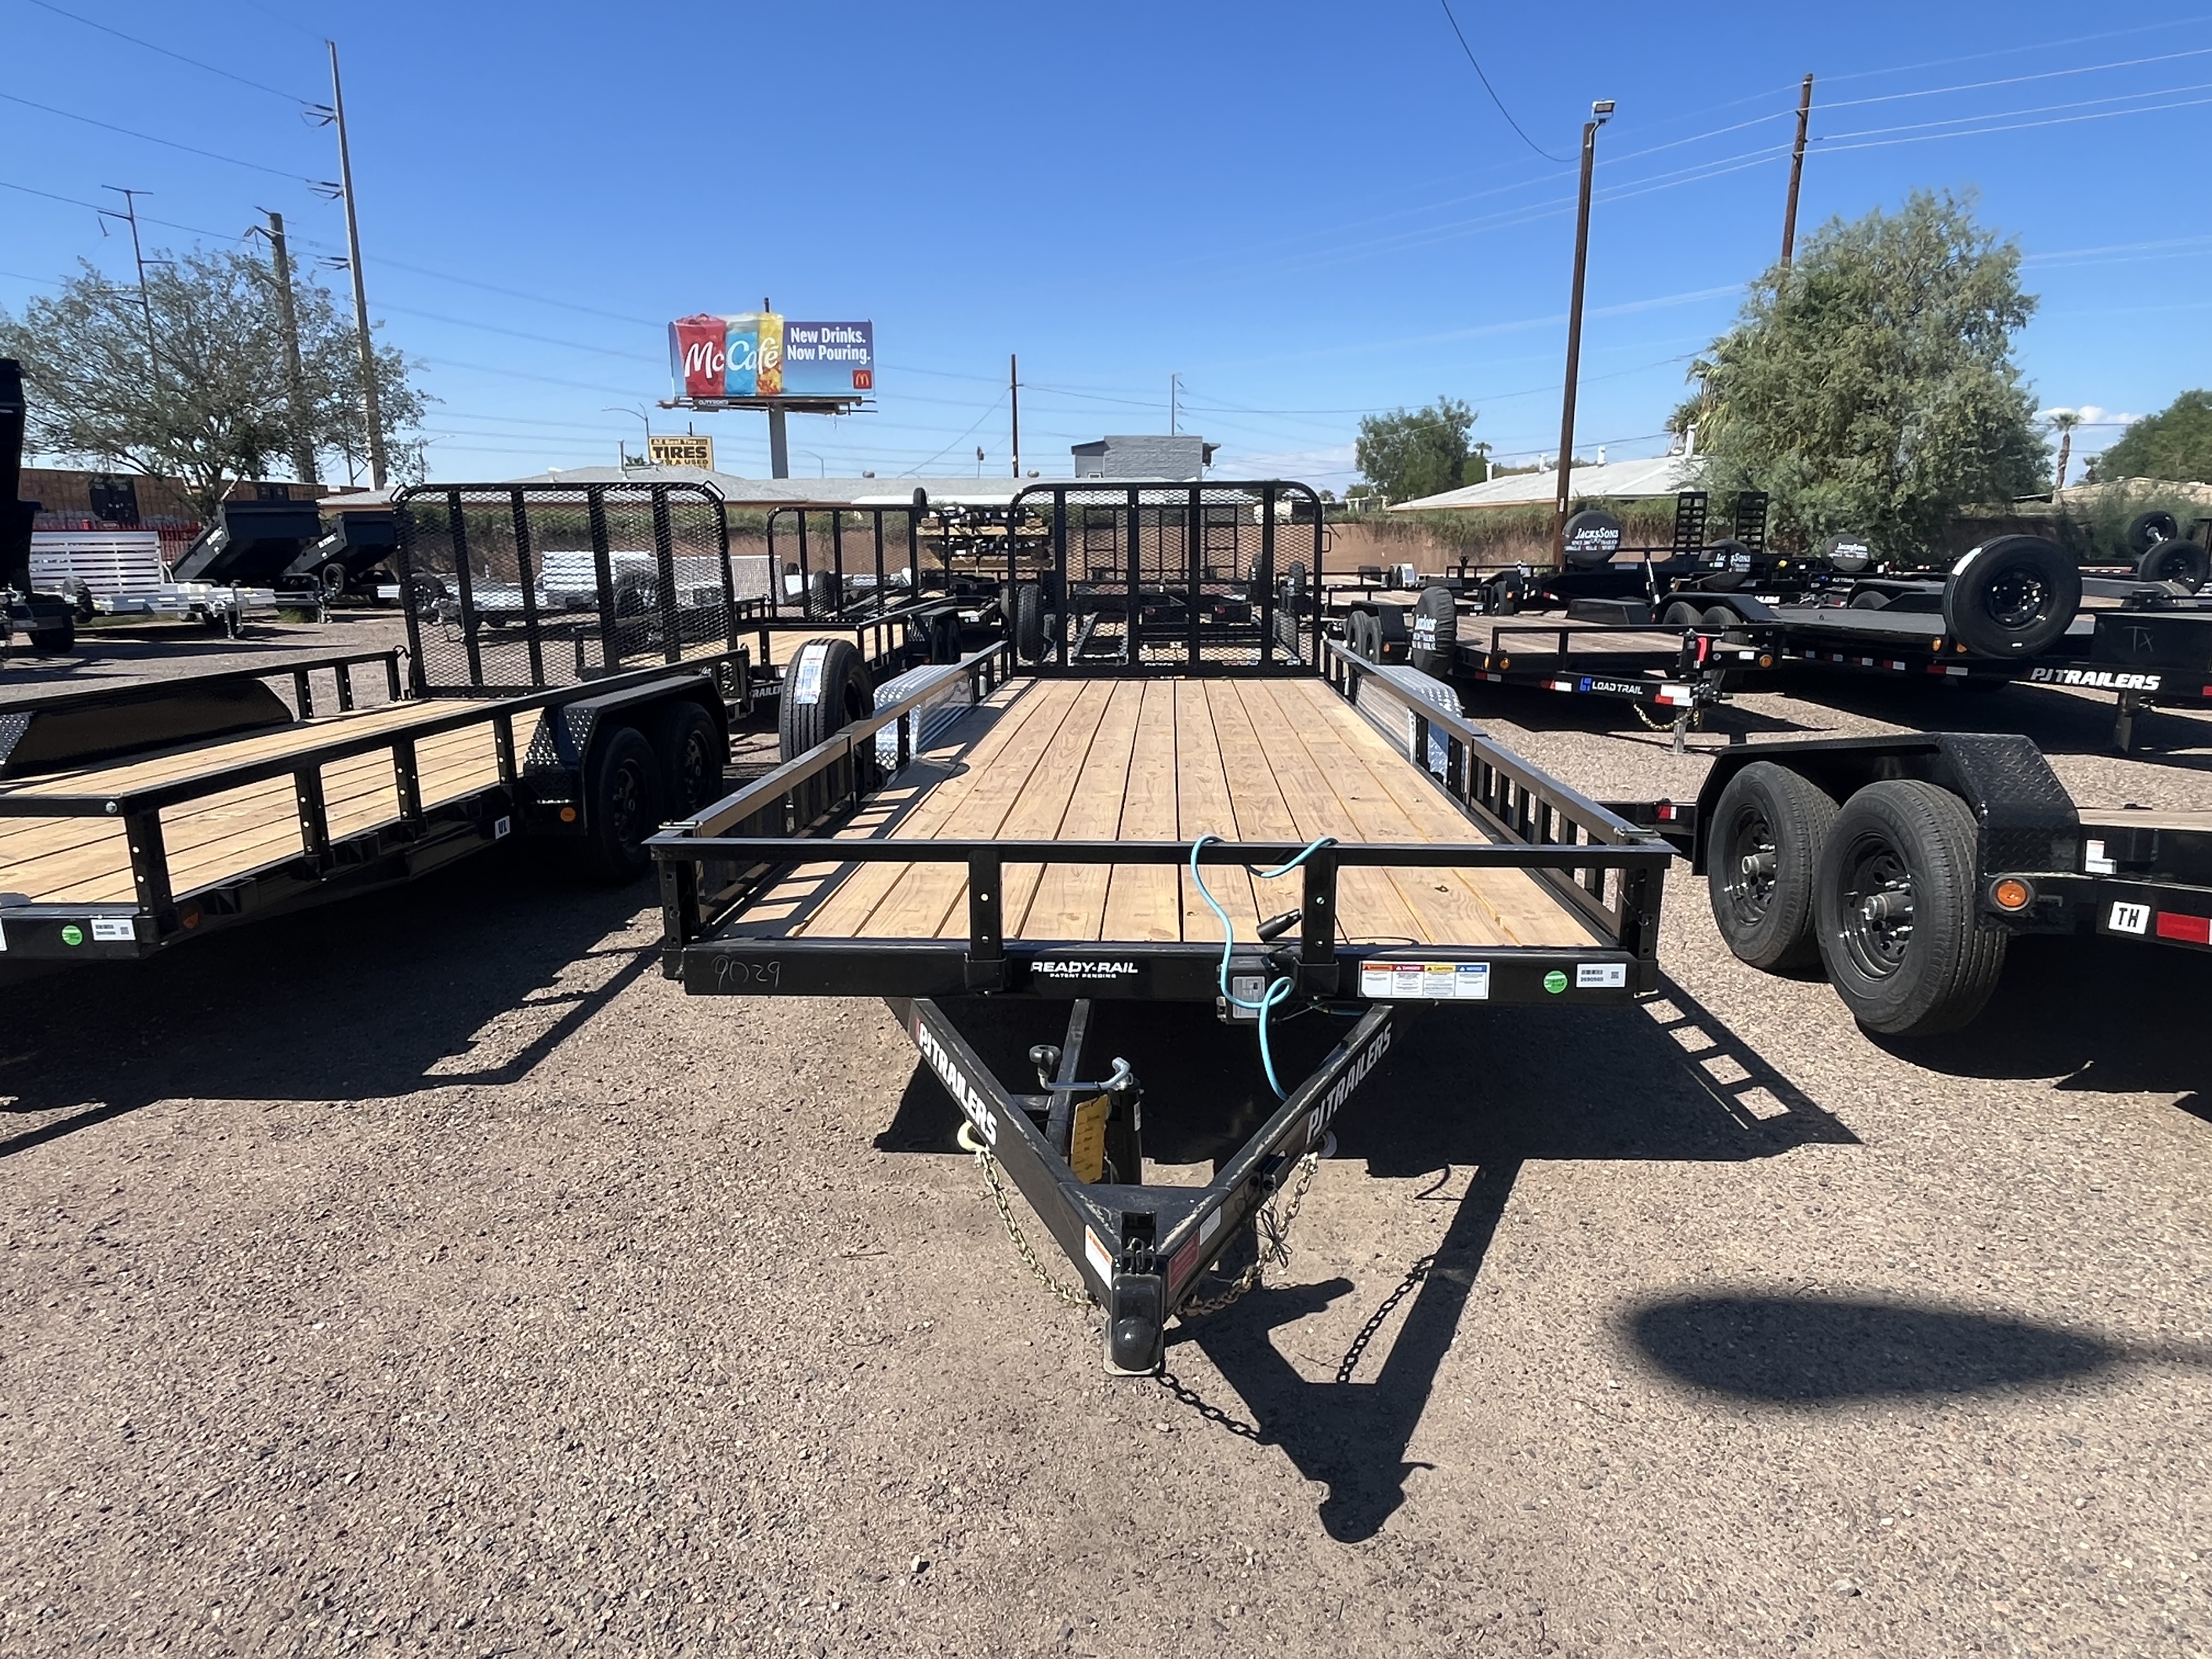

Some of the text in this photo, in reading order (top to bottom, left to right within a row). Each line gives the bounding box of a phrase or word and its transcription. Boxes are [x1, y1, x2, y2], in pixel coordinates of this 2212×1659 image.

[790, 326, 866, 343] New Drinks.
[685, 337, 780, 379] McCafé
[787, 345, 871, 364] Now Pouring.
[653, 447, 707, 458] TIRES
[2119, 907, 2141, 928] TH
